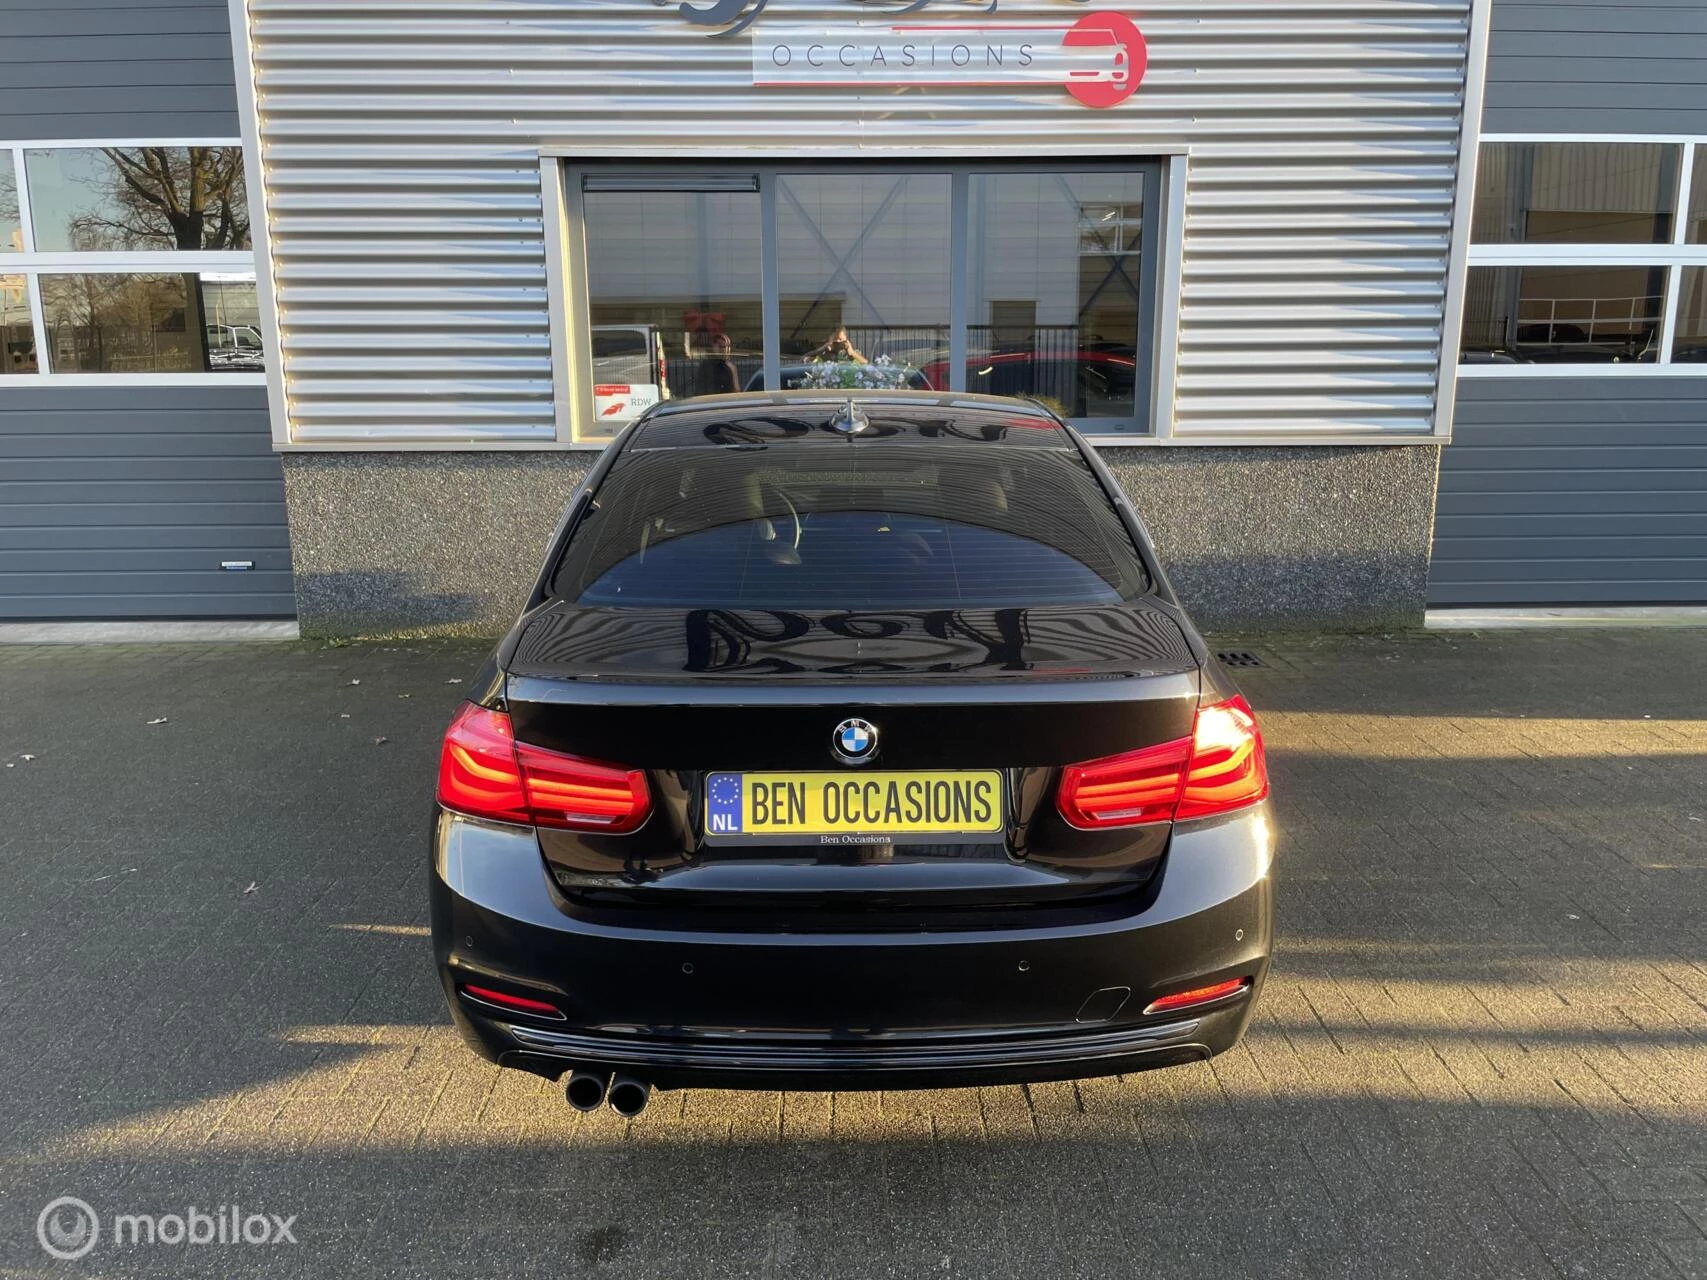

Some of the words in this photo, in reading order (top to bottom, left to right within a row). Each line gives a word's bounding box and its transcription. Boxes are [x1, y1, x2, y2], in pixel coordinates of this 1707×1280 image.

[772, 44, 1034, 66] OCCASIONS
[631, 398, 651, 406] RDW
[751, 781, 806, 825] BEN
[823, 780, 992, 824] OCCASIONS
[713, 814, 738, 830] NL
[821, 835, 839, 844] Ben
[842, 834, 891, 844] Occasions
